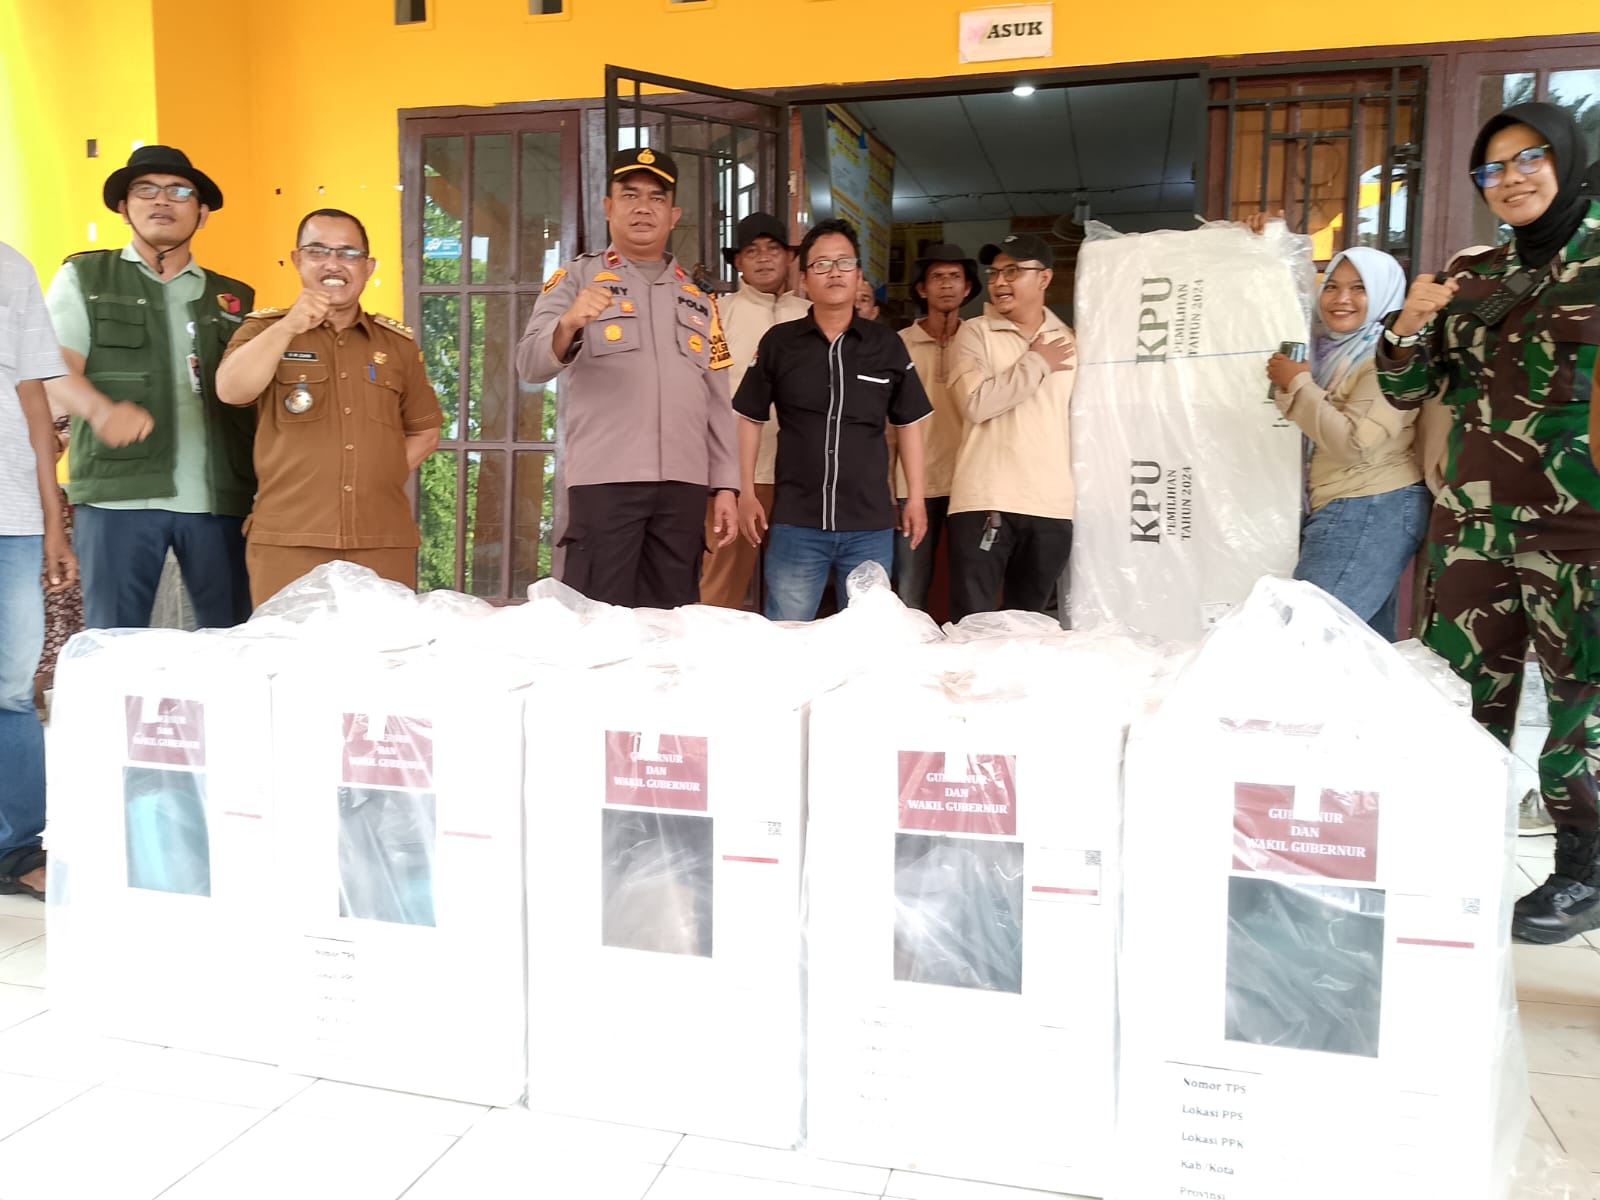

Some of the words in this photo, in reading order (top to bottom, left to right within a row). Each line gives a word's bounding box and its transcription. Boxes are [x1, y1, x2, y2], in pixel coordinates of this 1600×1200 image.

[1135, 276, 1172, 364] KPU
[1172, 283, 1188, 354] PEMILIHAN
[1188, 312, 1201, 357] TAHUN
[1182, 466, 1192, 496] 2024
[1130, 460, 1161, 544] KPU
[1166, 470, 1177, 536] PEMILIHAN
[1181, 499, 1192, 541] TAHUN
[645, 765, 667, 776] DAN
[613, 776, 646, 788] WAKIL
[646, 779, 701, 792] GUBERNUR
[944, 787, 969, 798] DAN
[907, 799, 945, 811] WAKIL
[945, 802, 1009, 814] GUBERNUR
[1290, 825, 1320, 838] DAN
[1246, 838, 1289, 852] WAKIL
[1291, 841, 1367, 858] GUBERNUR
[1183, 1077, 1222, 1092] Nomor
[1224, 1083, 1247, 1095] TPS
[1182, 1104, 1219, 1118] Lokasi
[1222, 1110, 1244, 1121] PPS
[1181, 1131, 1218, 1145] Lokasi
